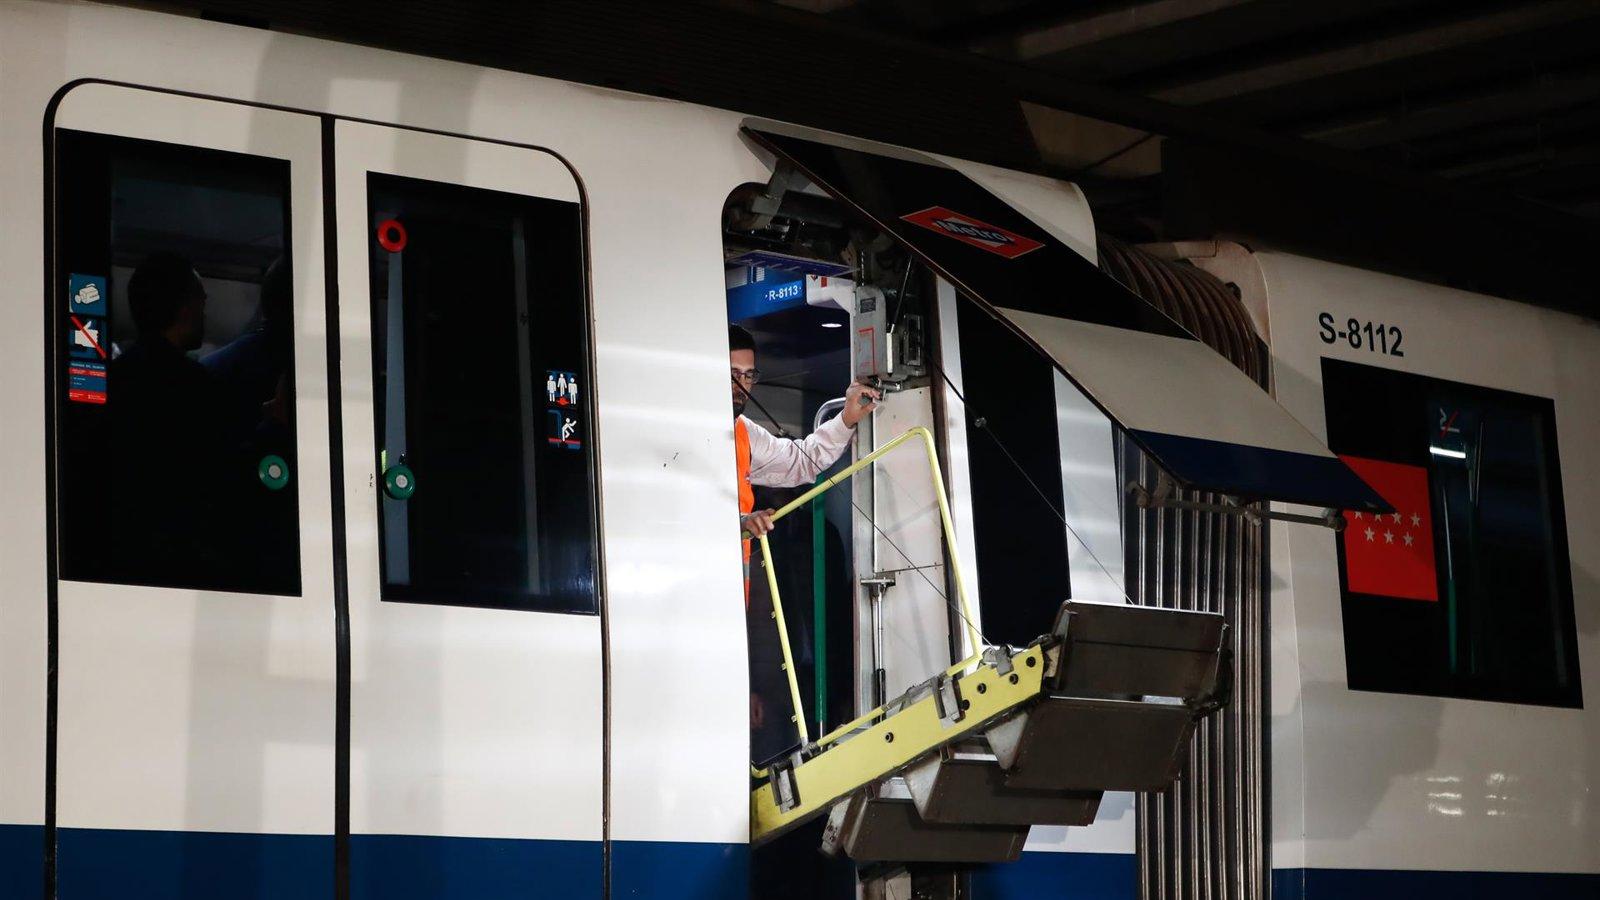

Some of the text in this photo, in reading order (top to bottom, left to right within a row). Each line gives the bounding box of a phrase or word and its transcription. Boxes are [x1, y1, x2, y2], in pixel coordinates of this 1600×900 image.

[935, 220, 1008, 242] Metro
[769, 285, 798, 300] R-8113
[1319, 312, 1404, 357] S-8112
